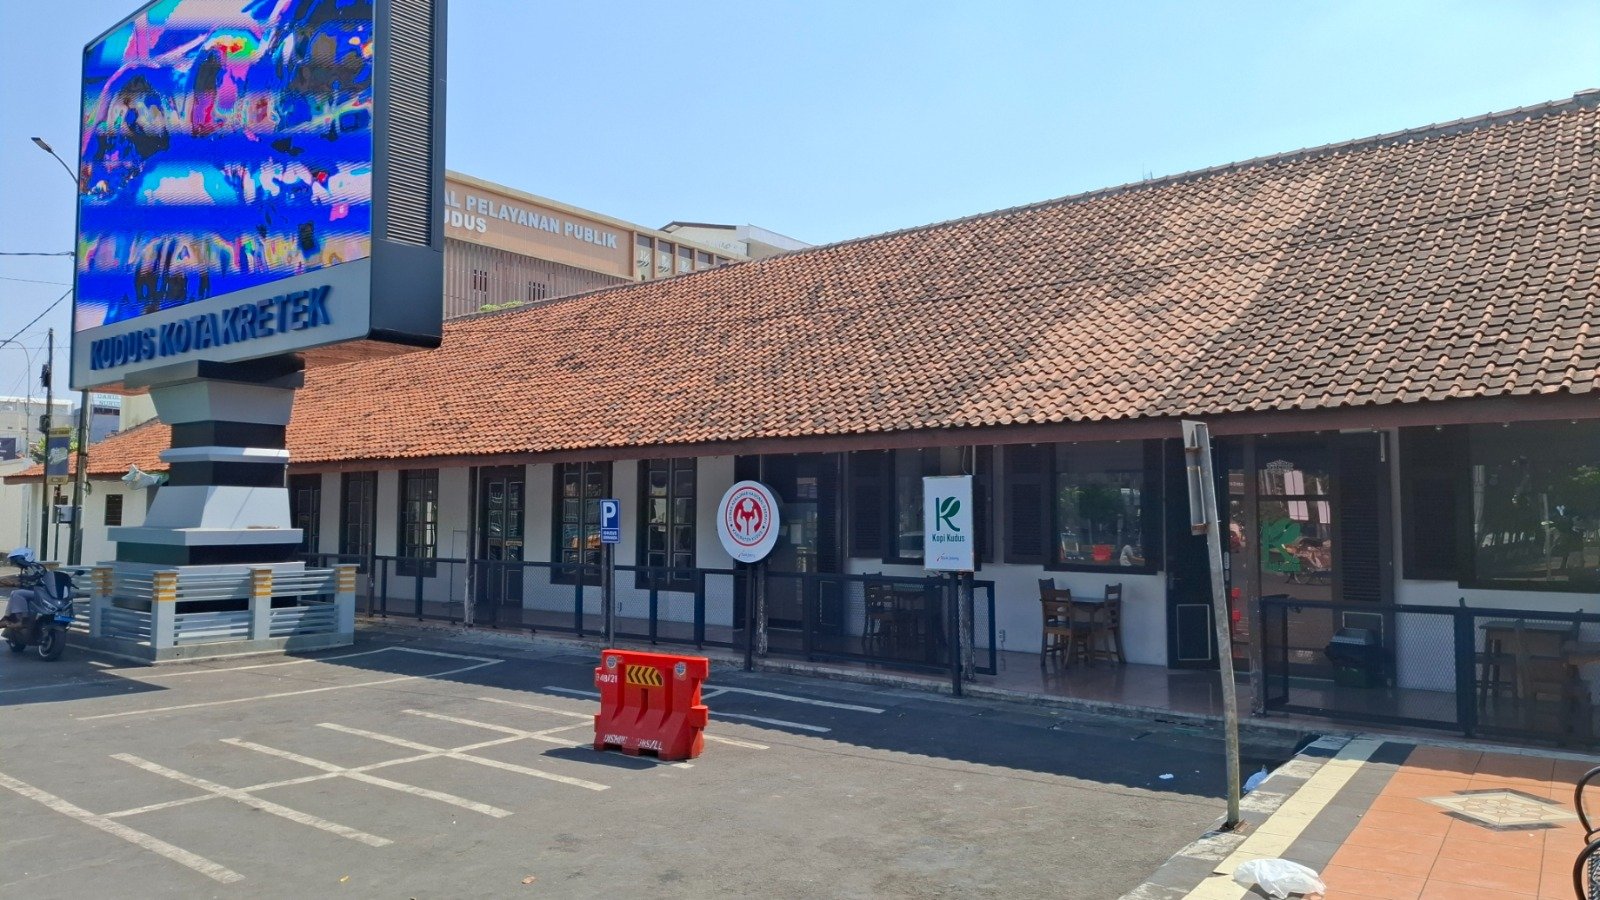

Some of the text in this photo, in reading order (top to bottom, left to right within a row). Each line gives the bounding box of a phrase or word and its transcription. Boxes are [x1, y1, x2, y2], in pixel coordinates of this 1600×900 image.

[466, 195, 560, 234] PELAYANAN
[564, 222, 617, 249] PUBLIK
[90, 284, 332, 371] KUDUS KOTA KRETEK
[603, 501, 617, 527] P
[932, 534, 965, 543] Kopi Kudus
